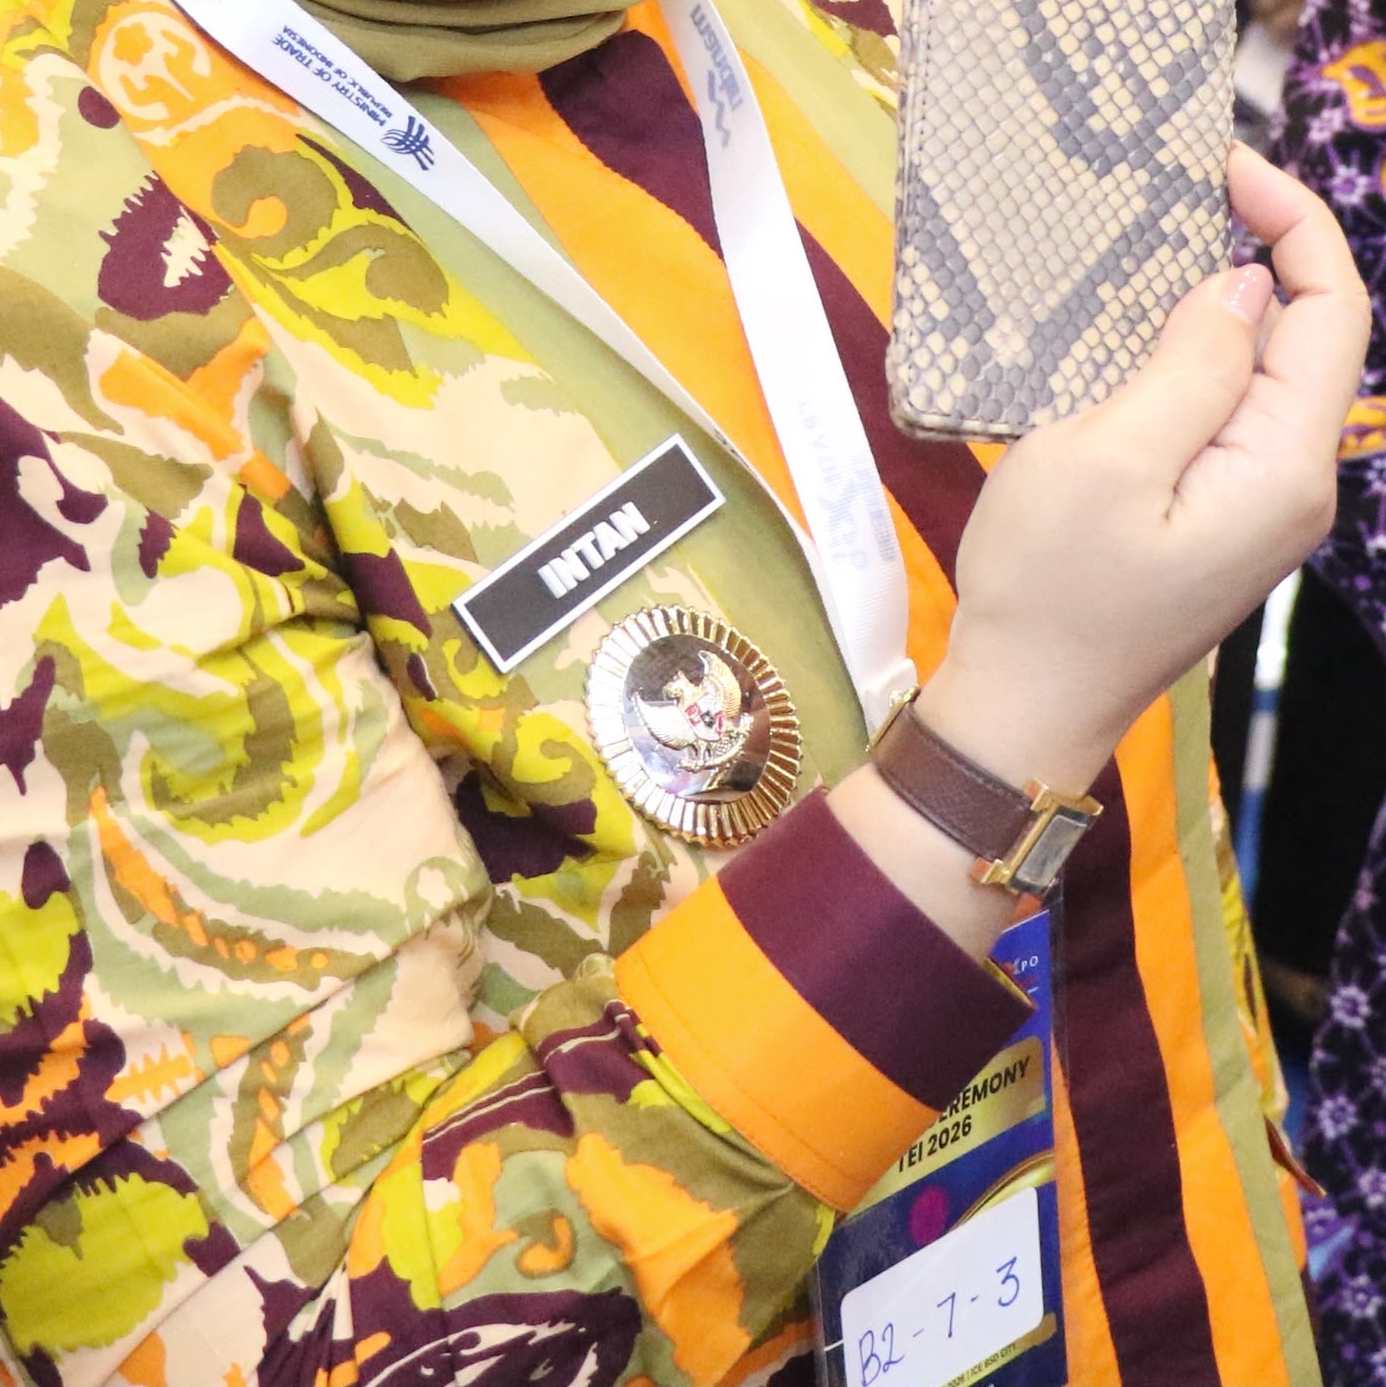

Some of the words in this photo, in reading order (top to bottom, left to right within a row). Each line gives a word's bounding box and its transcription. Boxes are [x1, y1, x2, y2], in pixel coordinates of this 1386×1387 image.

[271, 33, 313, 69] TRADE
[283, 25, 333, 68] INDONESIA
[312, 65, 333, 83] OF
[332, 81, 387, 127] MINISTRY
[347, 77, 392, 118] REPUBLIC
[537, 501, 651, 599] INTAN
[927, 1115, 972, 1157] 2026
